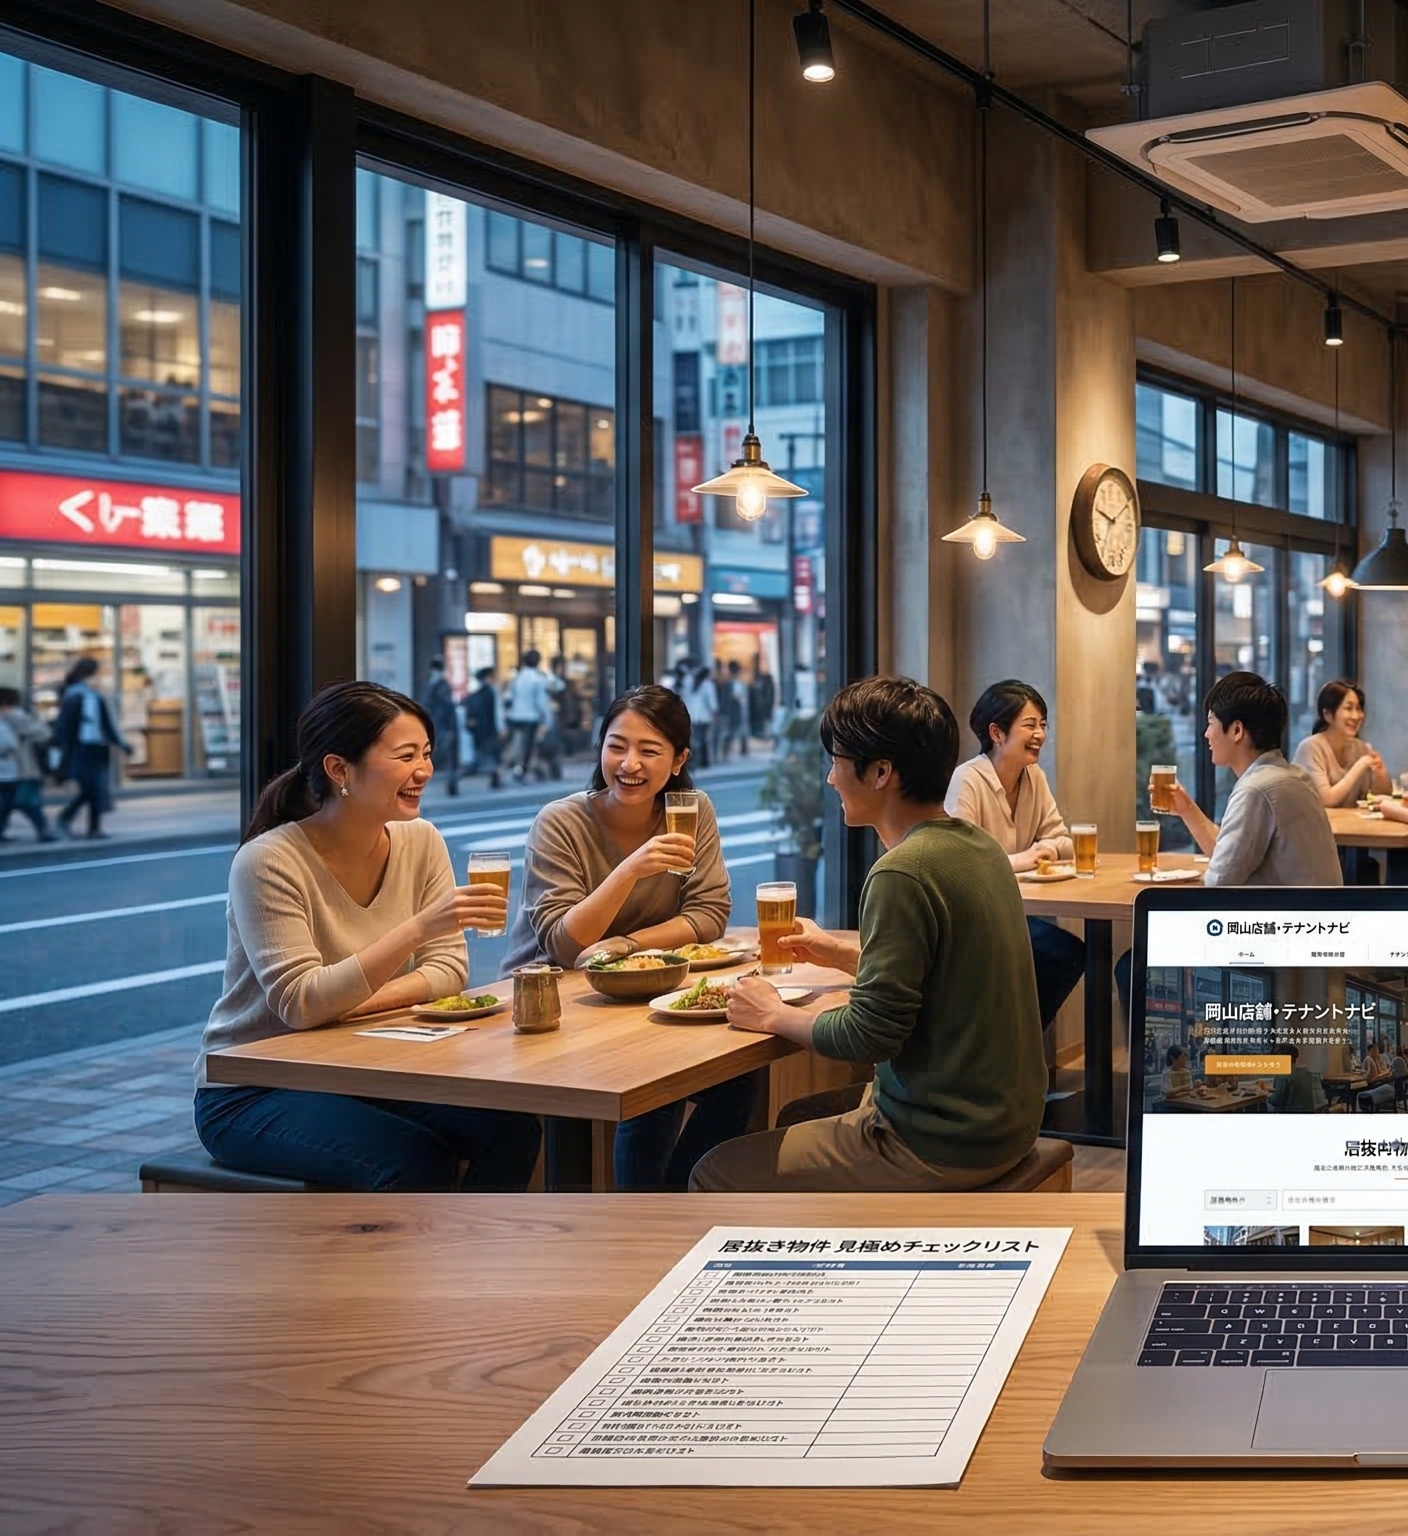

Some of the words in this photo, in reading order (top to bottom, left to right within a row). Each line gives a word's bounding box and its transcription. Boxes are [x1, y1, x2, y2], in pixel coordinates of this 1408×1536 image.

[1204, 1001, 1377, 1022] 岡山店舗・テナントナビ
[717, 1238, 832, 1254] 居抜き物件
[833, 1238, 1040, 1254] 見極めチェックリスト
